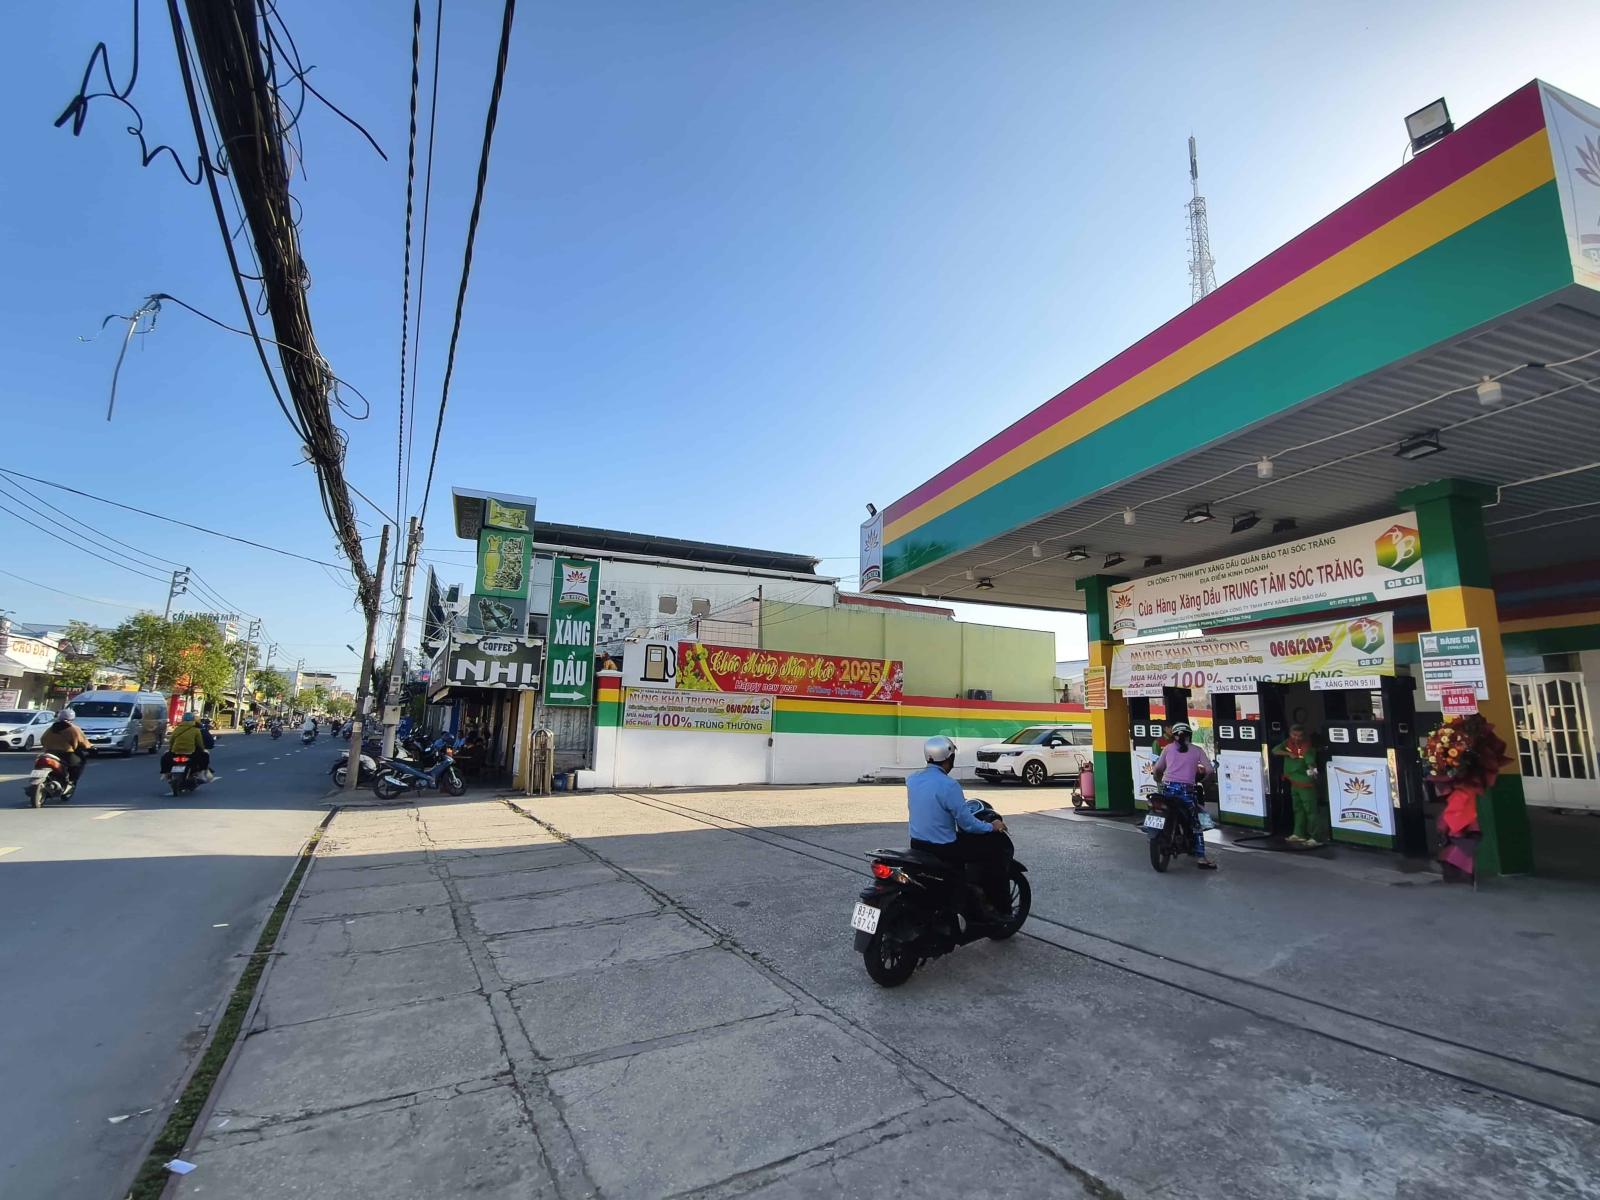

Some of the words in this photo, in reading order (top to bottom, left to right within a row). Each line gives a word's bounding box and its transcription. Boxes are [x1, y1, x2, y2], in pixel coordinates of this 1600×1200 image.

[1156, 577, 1170, 585] CÔNG
[1291, 542, 1306, 554] SÓC
[1308, 536, 1336, 550] TRĂNG
[1227, 568, 1243, 578] KINH
[1244, 563, 1268, 575] DOANH
[1156, 598, 1176, 616] Hàng
[1180, 593, 1201, 611] Xăng
[1222, 579, 1258, 602] TRUNG
[1260, 571, 1286, 594] TÂM
[1289, 564, 1314, 589] SÓC
[1316, 557, 1364, 585] TRĂNG
[554, 614, 591, 646] XĂNG
[482, 642, 513, 652] COFFEE
[1270, 636, 1333, 657] 06/6/2025
[456, 658, 532, 684] NHI
[552, 651, 587, 686] DẦU
[840, 660, 880, 683] 2025
[735, 680, 762, 692] Happy
[780, 684, 797, 693] year
[662, 695, 684, 704] KHAI
[726, 704, 760, 714] 06/6/2025
[654, 713, 692, 728] 100%
[695, 720, 724, 729] TRÚNG
[726, 720, 763, 730] THƯỞNG
